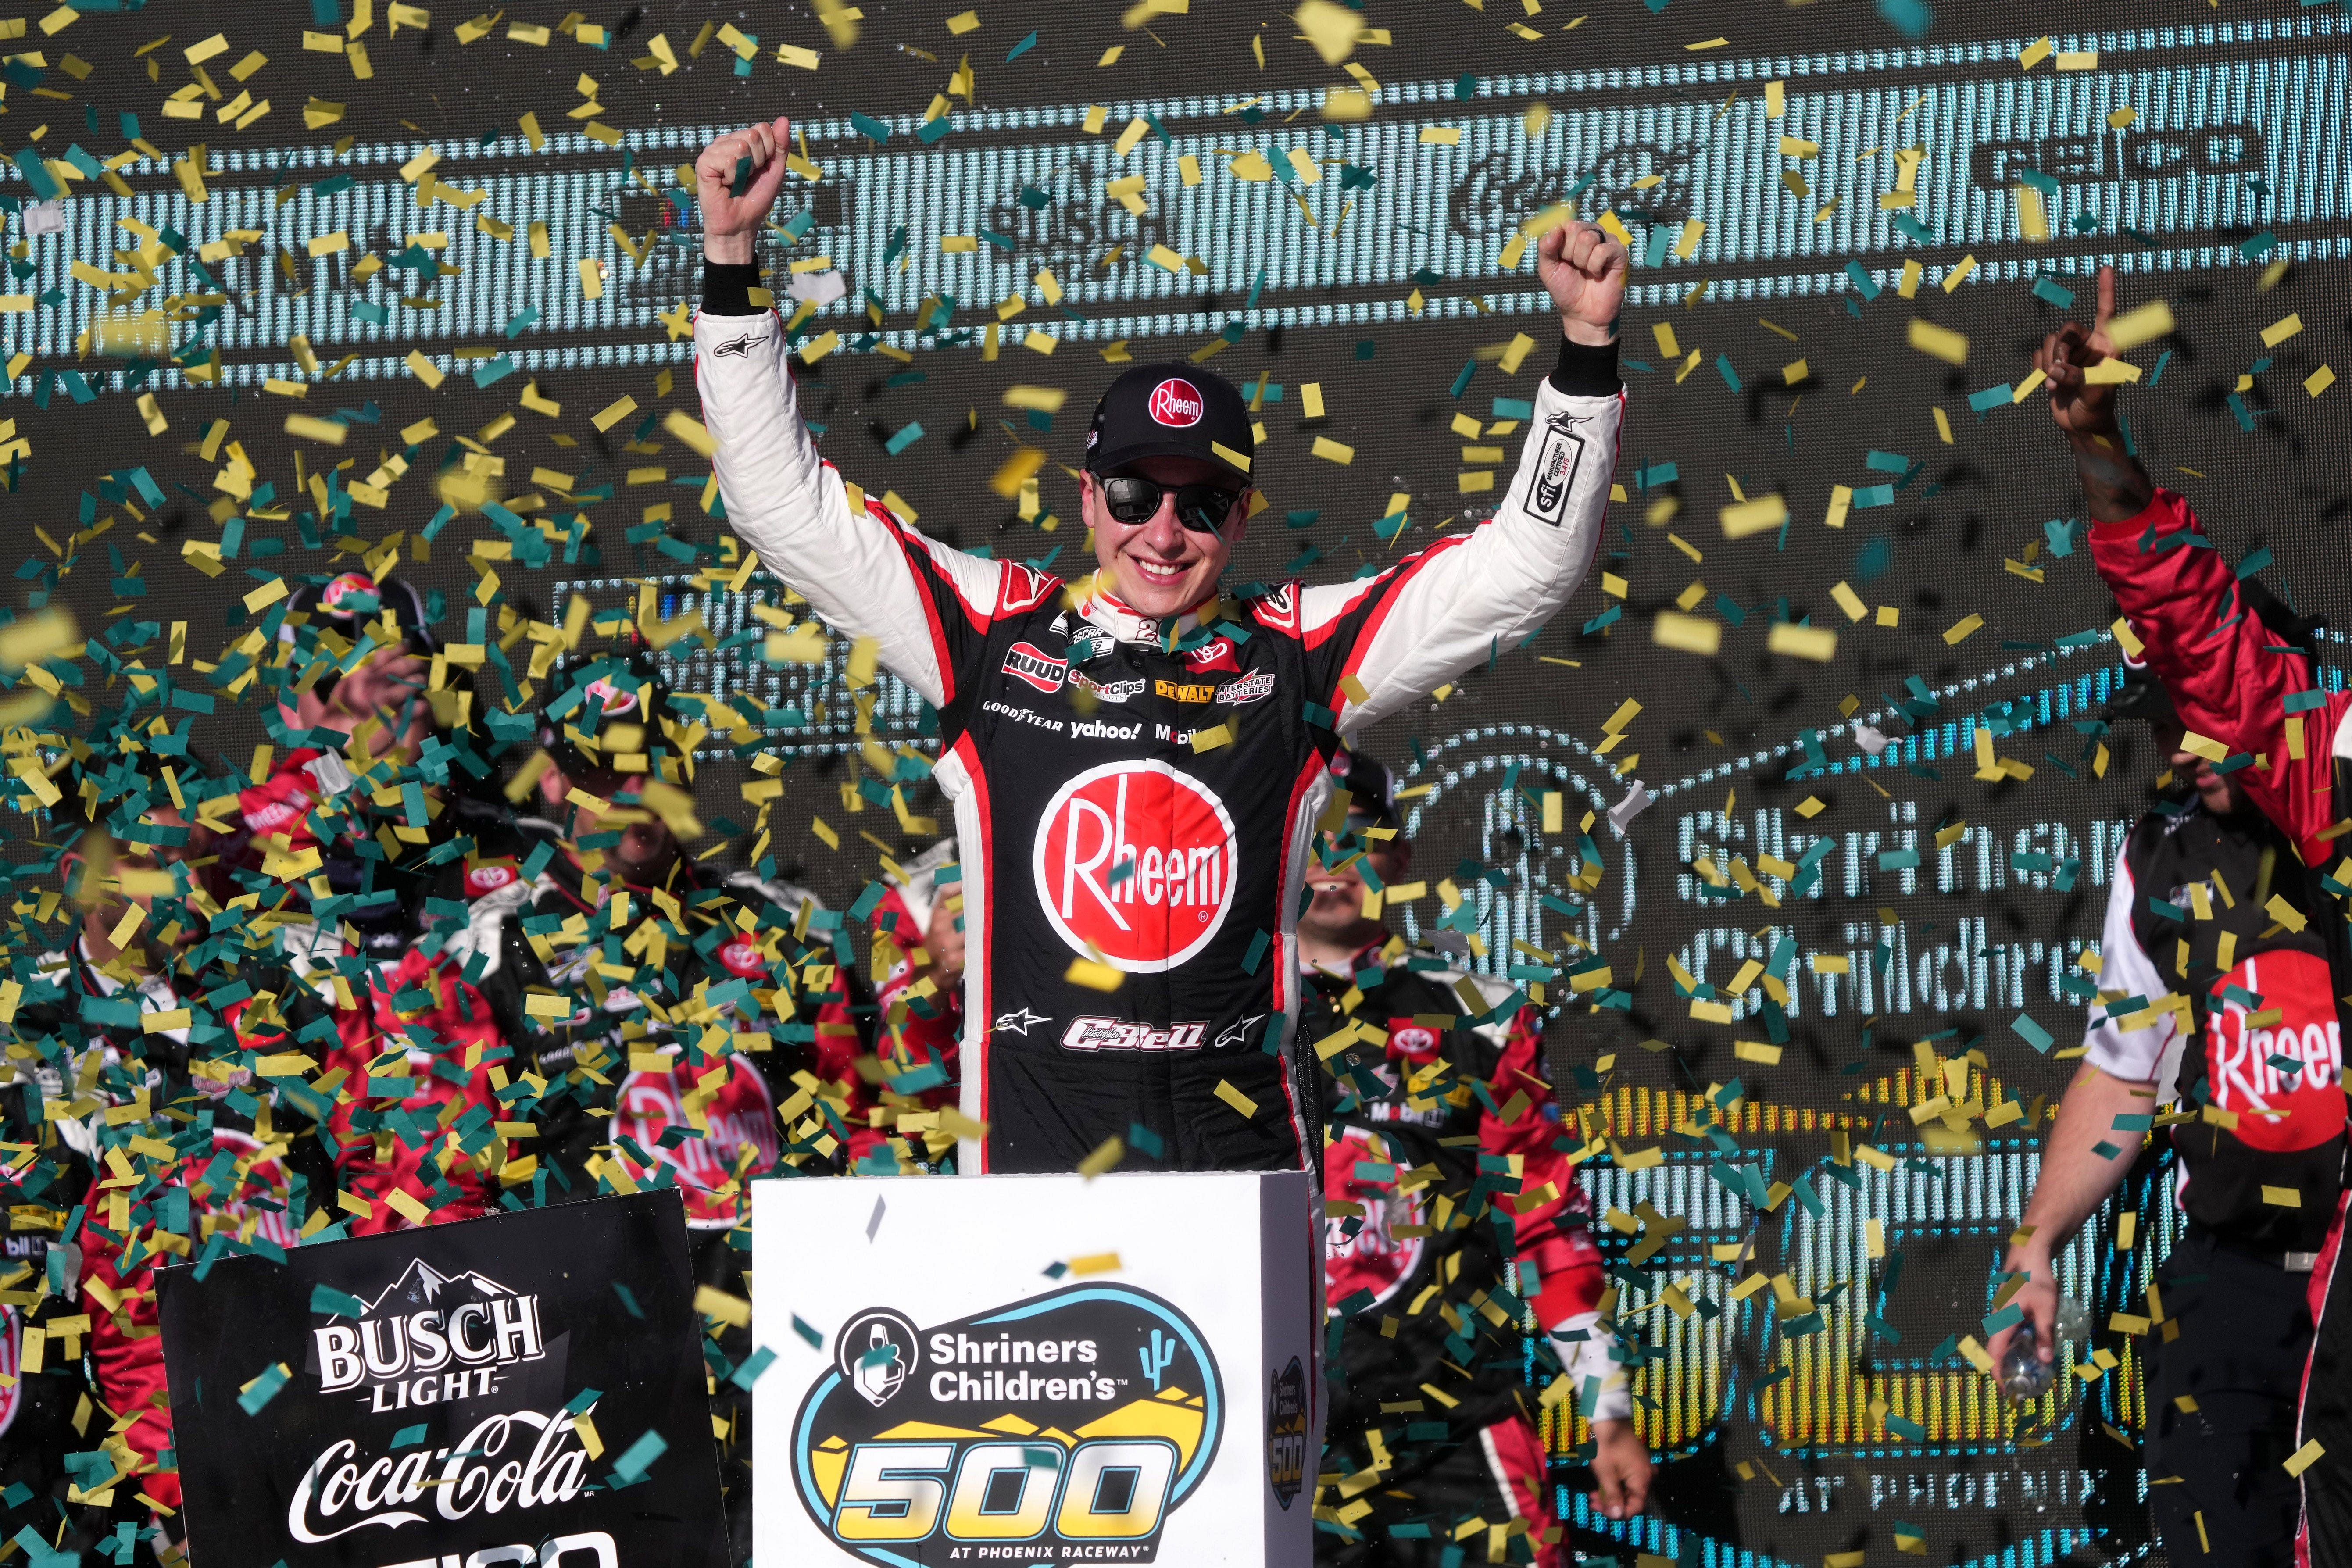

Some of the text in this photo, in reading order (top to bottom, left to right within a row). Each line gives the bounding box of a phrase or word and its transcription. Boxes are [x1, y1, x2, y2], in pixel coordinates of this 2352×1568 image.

[1156, 380, 1199, 419] Rheem
[1547, 442, 1562, 481] MANUFACTURER
[1553, 451, 1565, 477] CERTIFIED
[1004, 651, 1065, 682] RUUD
[1217, 677, 1270, 693] INTERSTATE
[1219, 685, 1269, 701] BATTERIES
[1070, 719, 1142, 740] yahoo!
[1062, 774, 1220, 931] Rheem
[1678, 800, 2127, 908] Shriner
[1675, 916, 2104, 1020] Childre
[313, 1294, 546, 1394] BUSCH
[929, 1332, 1097, 1364] Shriners
[371, 1366, 497, 1414] LIGHT
[929, 1370, 1115, 1402] Children's
[288, 1400, 598, 1543] Coca-Cola
[1272, 1434, 1303, 1485] 500
[833, 1441, 1177, 1543] 500
[949, 1545, 1143, 1559] AT PHOENIX RACEWAY
